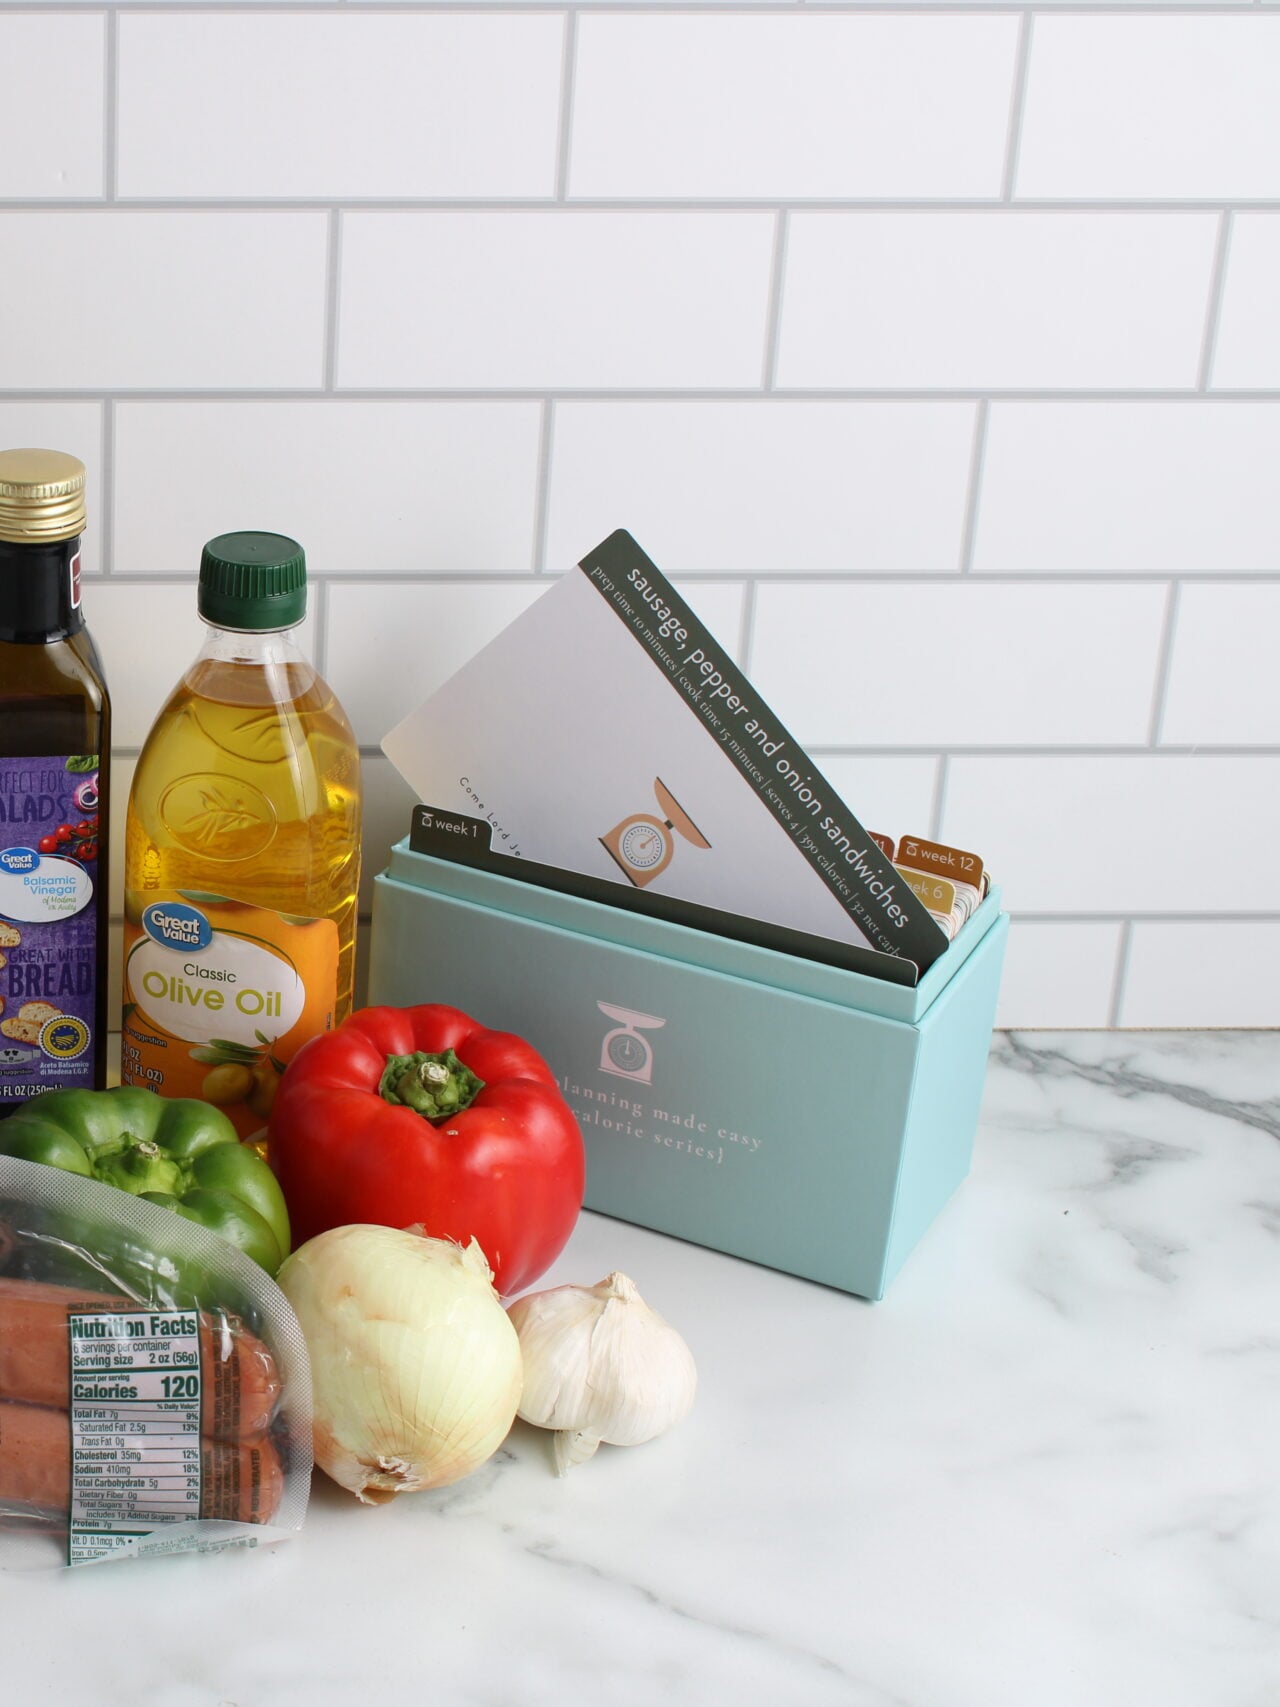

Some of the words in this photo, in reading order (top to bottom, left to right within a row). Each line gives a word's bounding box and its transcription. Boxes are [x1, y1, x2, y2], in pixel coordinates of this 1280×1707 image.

[590, 566, 615, 592] prep
[613, 590, 635, 616] time
[643, 628, 678, 672] minutes
[679, 675, 702, 702] cook
[699, 702, 721, 727] time
[729, 739, 765, 783] minutes
[765, 787, 793, 820] serves
[800, 834, 818, 854] 390
[817, 853, 851, 896] calories
[850, 901, 864, 916] 32
[862, 914, 880, 933] net
[627, 569, 688, 650] sausage,
[683, 649, 749, 715] pepper
[744, 719, 785, 758] and
[776, 759, 822, 816] onion
[820, 816, 909, 929] sandwiches
[40, 770, 65, 793] FOR
[460, 777, 485, 809] Come
[487, 812, 511, 840] Lord
[435, 821, 468, 836] week
[472, 825, 478, 838] 1
[1, 854, 32, 863] Great
[921, 848, 956, 867] week
[959, 857, 975, 871] 12
[24, 876, 76, 886] Balsamic
[30, 886, 77, 896] Vinegar
[933, 885, 943, 899] 6
[150, 910, 200, 935] Great
[161, 928, 200, 944] Value
[9, 948, 53, 963] GREAT
[59, 947, 90, 962] WITH
[9, 962, 91, 997] BREAD
[183, 963, 237, 983] Classic
[142, 971, 225, 1011] Olive
[235, 989, 282, 1017] Oil
[130, 1048, 140, 1061] OZ
[135, 1064, 144, 1077] FL
[146, 1069, 163, 1083] OZ)
[3, 1086, 13, 1096] FL
[15, 1085, 26, 1096] OZ
[654, 1109, 707, 1132] made
[717, 1128, 763, 1152] easy
[72, 1316, 145, 1338] Nutrition
[150, 1315, 196, 1336] Facts
[81, 1344, 115, 1354] servings
[118, 1343, 131, 1354] per
[133, 1341, 171, 1351] container
[74, 1356, 111, 1367] Serving
[114, 1354, 133, 1365] size
[149, 1353, 156, 1364] 2
[158, 1356, 169, 1364] oz
[172, 1352, 198, 1365] (56g)
[108, 1374, 130, 1382] serving
[74, 1383, 138, 1399] Calories
[161, 1375, 198, 1398] 120
[74, 1410, 92, 1418] Total
[94, 1410, 106, 1418] Fat
[110, 1411, 118, 1419] 7g
[80, 1423, 113, 1431] Saturated
[115, 1423, 126, 1431] Fat
[130, 1423, 146, 1433] 2.5g
[81, 1437, 99, 1446] Trans
[101, 1437, 112, 1446] Fat
[116, 1438, 125, 1447] 0g
[75, 1451, 117, 1460] Cholesterol
[121, 1451, 141, 1461] 35mg
[183, 1450, 198, 1459] 12%
[75, 1465, 103, 1474] Sodium
[106, 1465, 131, 1475] 410mg
[183, 1465, 199, 1473] 18%
[75, 1478, 93, 1487] Total
[95, 1478, 145, 1488] Carbohydrate
[149, 1479, 158, 1489] 5g
[187, 1479, 198, 1487] 2%
[80, 1491, 105, 1499] Dietary
[128, 1491, 137, 1500] 0g
[97, 1501, 122, 1509] Sugars
[86, 1511, 115, 1519] Includes
[73, 1520, 99, 1528] Protein
